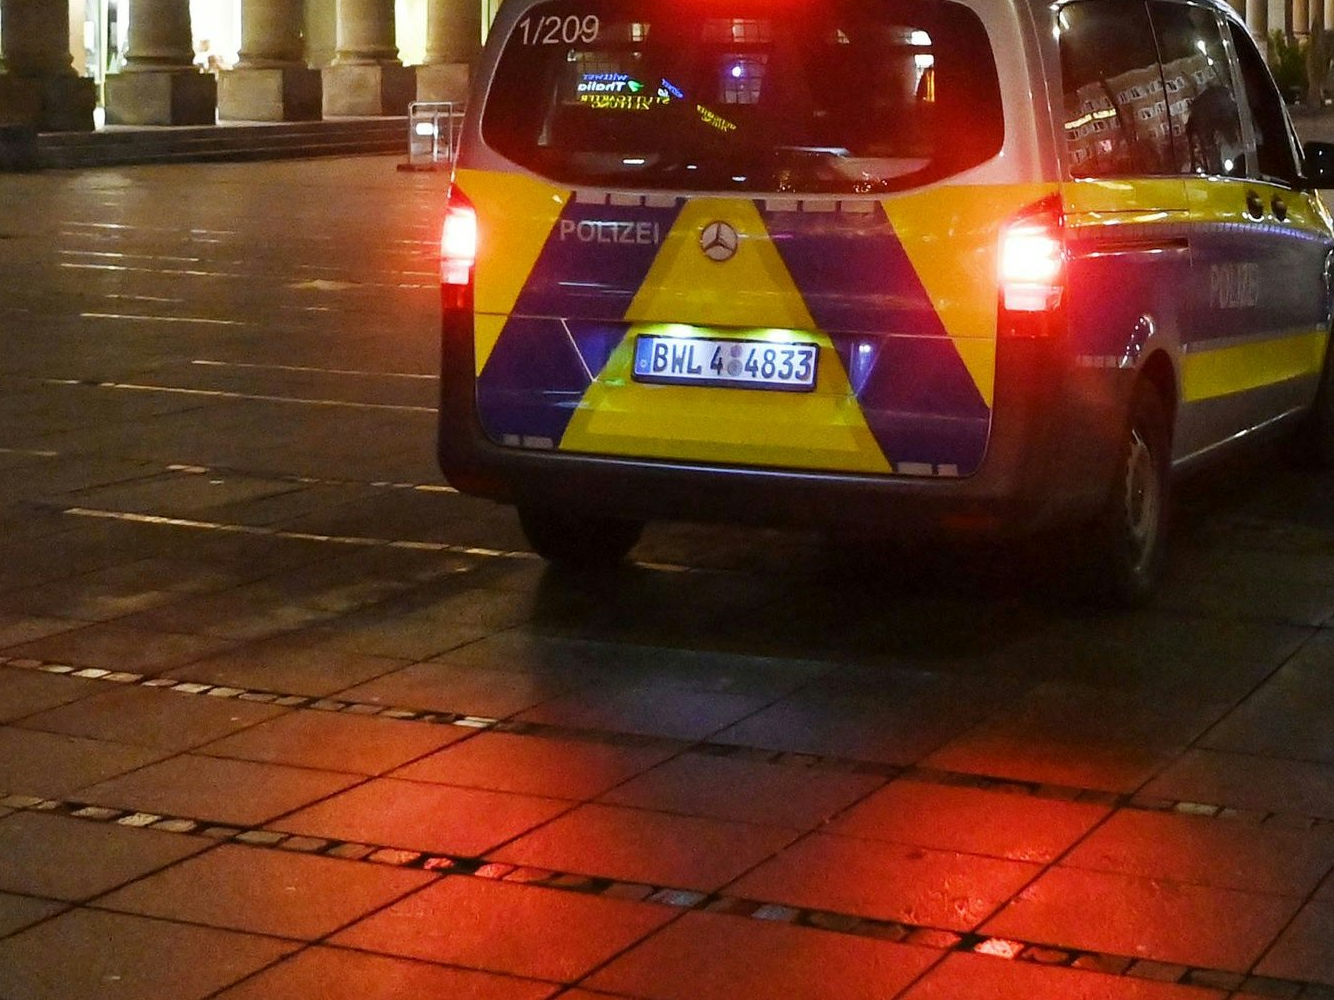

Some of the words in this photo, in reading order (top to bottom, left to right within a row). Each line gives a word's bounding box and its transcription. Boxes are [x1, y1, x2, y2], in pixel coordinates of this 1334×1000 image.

[520, 15, 599, 45] 1/209
[560, 220, 660, 244] POLIZEI
[653, 343, 702, 375] BWL
[710, 346, 723, 375] 4
[744, 348, 813, 381] 4833
